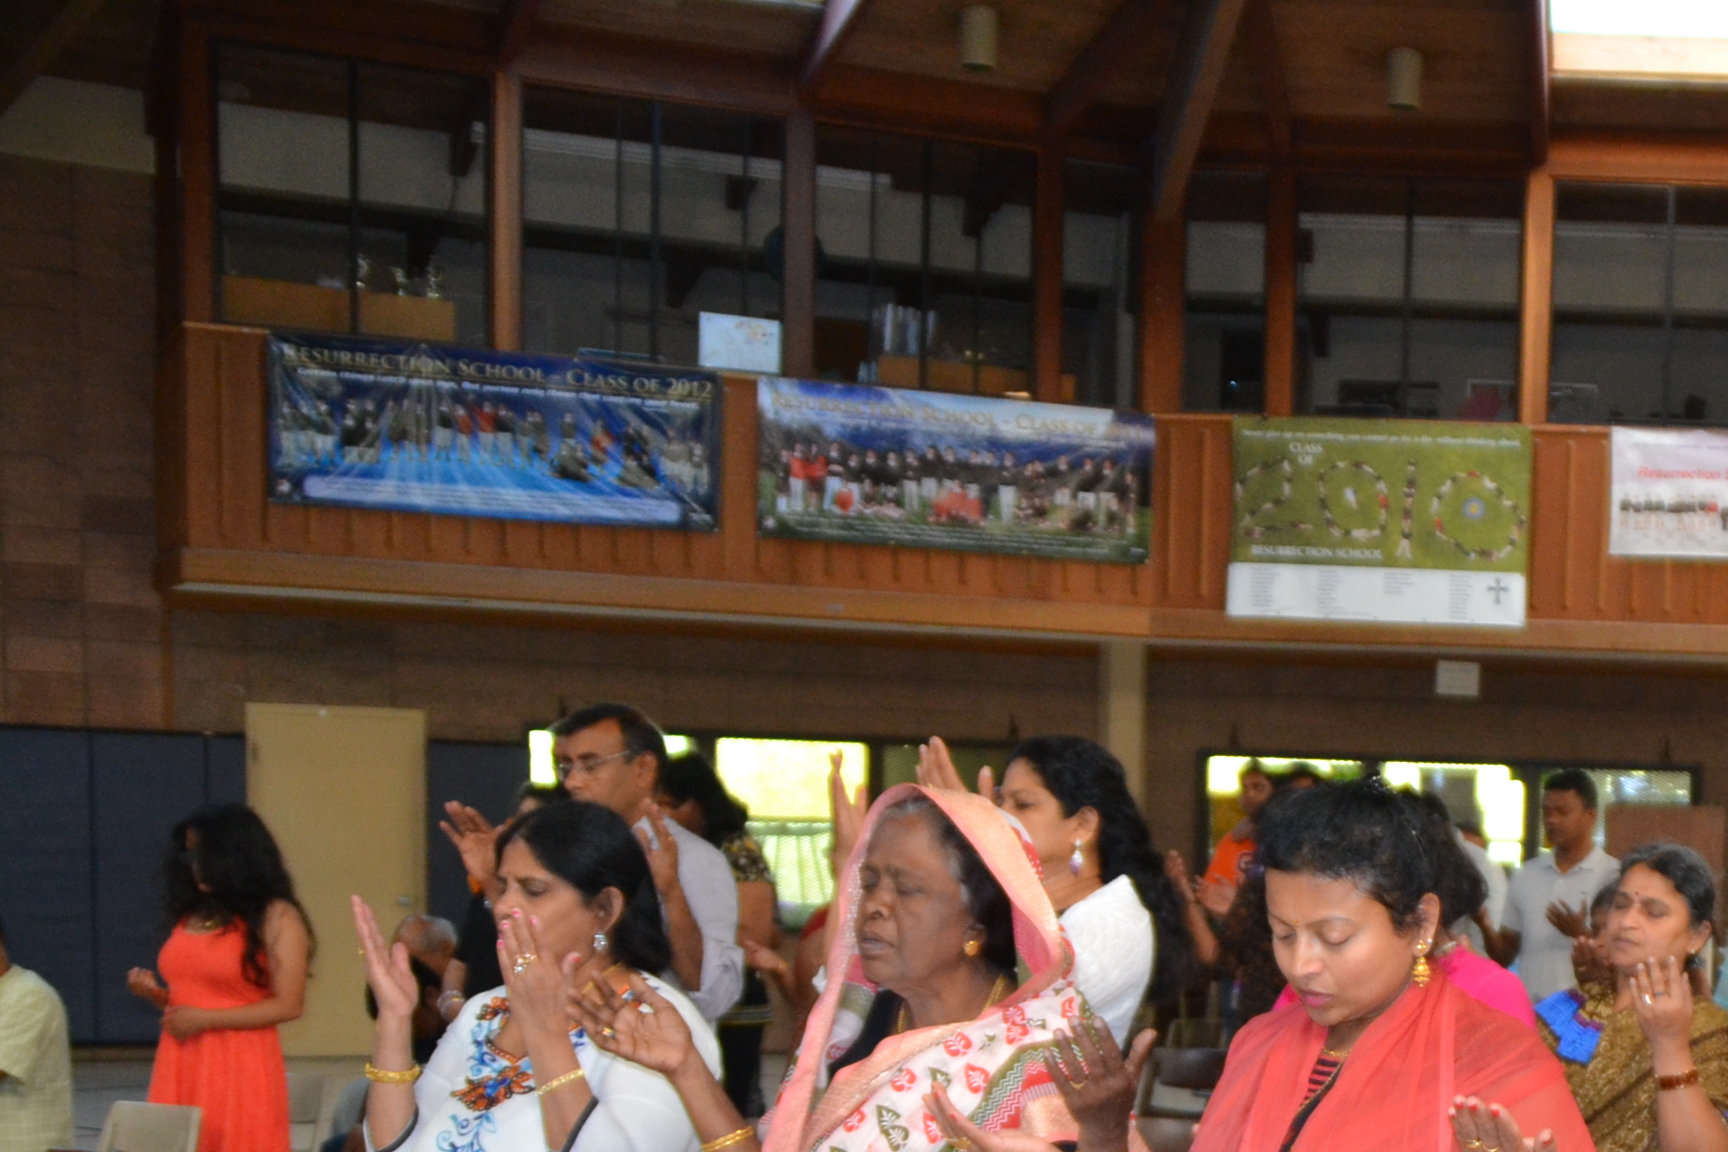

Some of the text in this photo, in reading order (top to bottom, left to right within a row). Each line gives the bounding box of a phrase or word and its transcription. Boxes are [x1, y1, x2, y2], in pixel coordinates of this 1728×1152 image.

[282, 345, 452, 375] RESURRECTION
[458, 357, 546, 383] SCHOOL
[566, 367, 628, 390] CLASS
[633, 376, 661, 393] OF
[667, 377, 713, 398] 2012
[922, 403, 997, 427] SCHOOL
[1015, 413, 1069, 433] CLASS
[1336, 547, 1383, 560] SCHOOL
